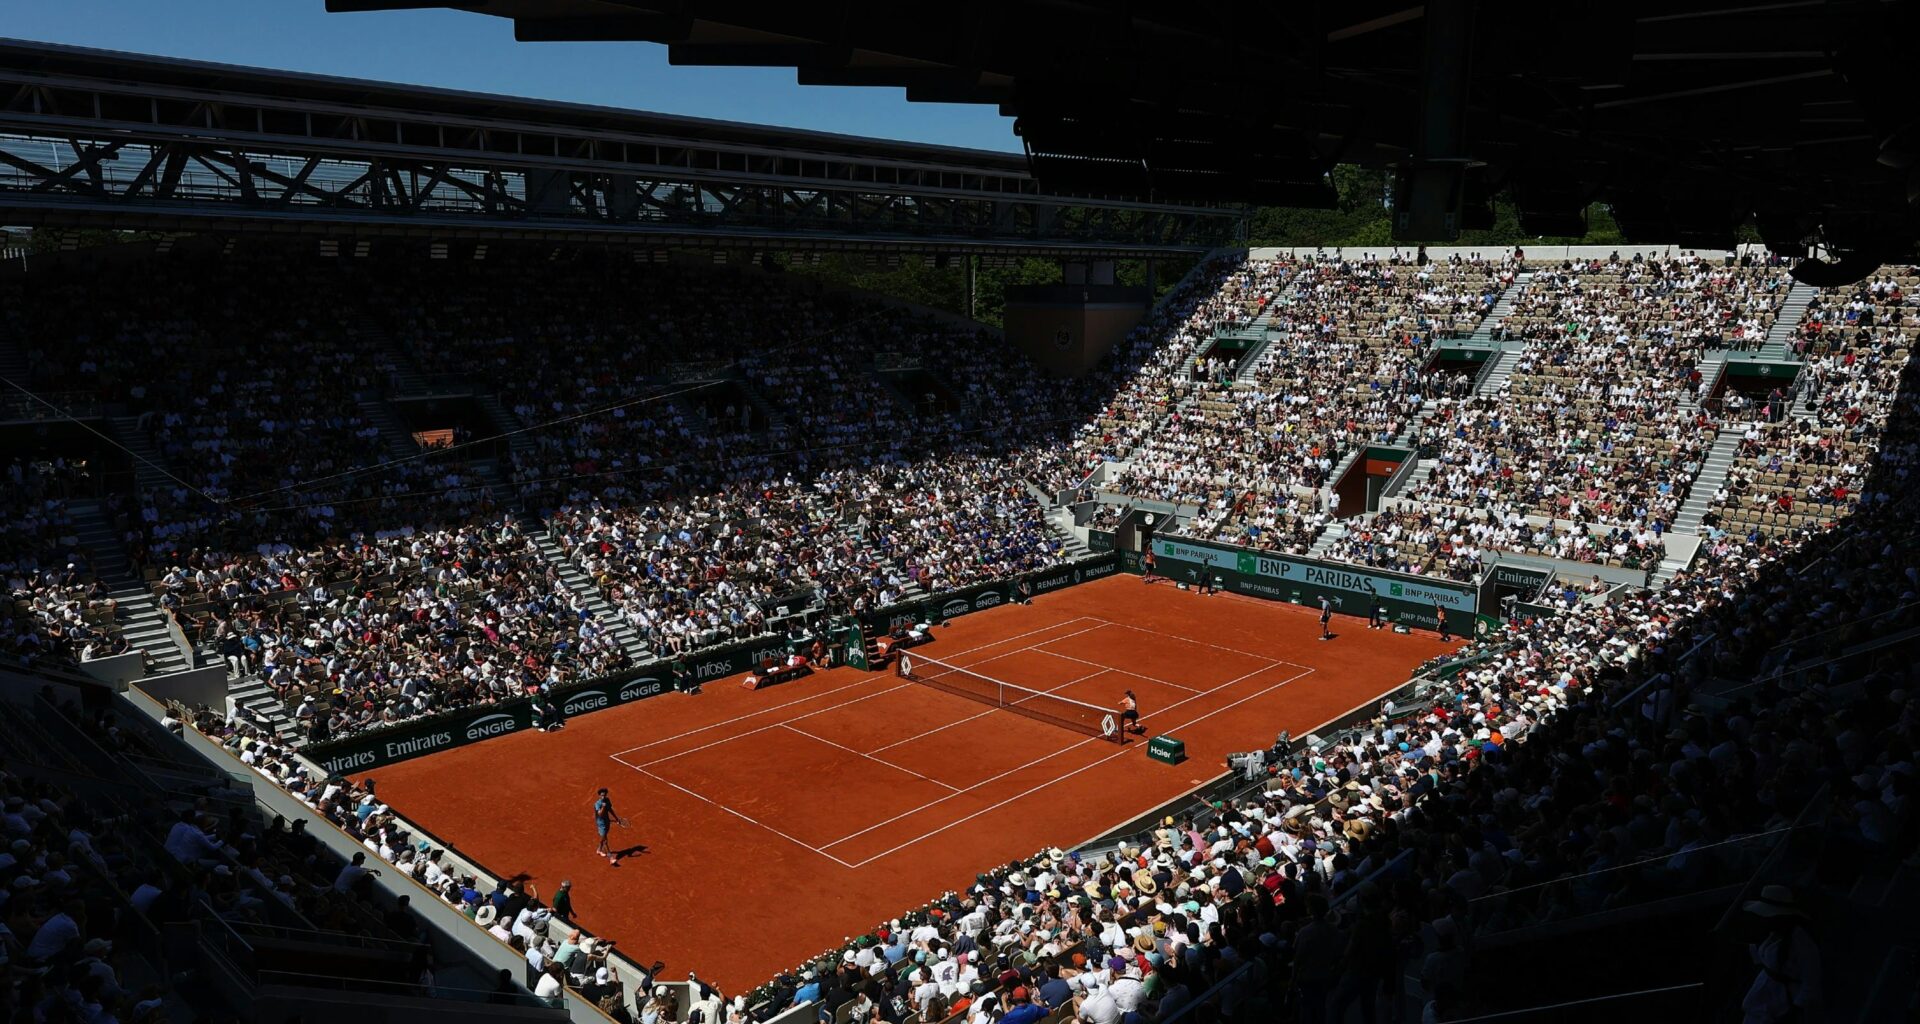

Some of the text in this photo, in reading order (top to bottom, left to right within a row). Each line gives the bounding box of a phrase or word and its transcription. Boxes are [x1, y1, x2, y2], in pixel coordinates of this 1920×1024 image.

[1175, 547, 1218, 561] BNP PARIBAS
[1085, 563, 1115, 577] RENAULT
[1260, 559, 1373, 592] BNP PARIBAS
[1497, 570, 1545, 585] Emirates
[1037, 575, 1069, 590] RENAULT
[1240, 581, 1280, 595] BNP PARIBAS
[1404, 588, 1460, 604] BNP PARIBAS
[1400, 612, 1438, 625] BNP PARIB
[696, 659, 732, 679] Infosys
[386, 731, 452, 759] Emirates
[1150, 745, 1172, 759] Haier
[321, 750, 376, 772] irates
